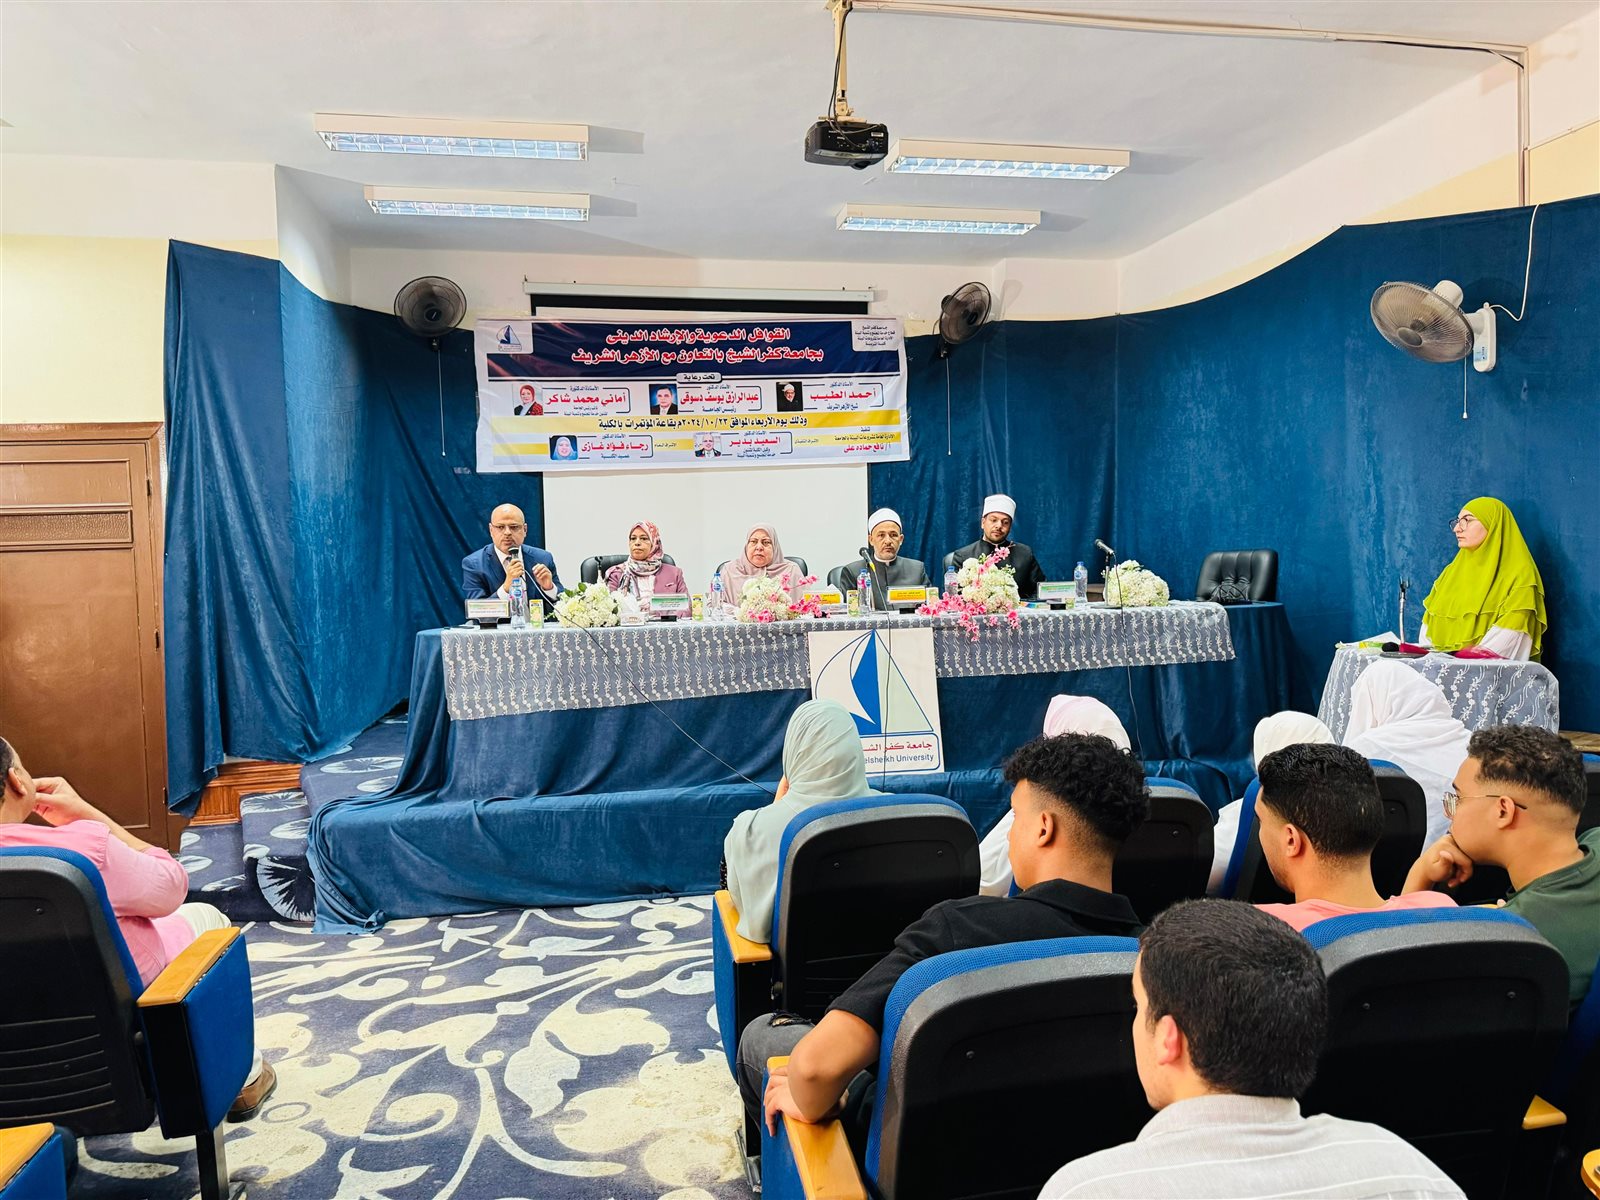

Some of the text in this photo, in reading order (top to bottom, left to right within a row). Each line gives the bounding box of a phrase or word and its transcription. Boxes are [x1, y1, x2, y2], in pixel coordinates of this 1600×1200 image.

[697, 328, 746, 343] الدعوية
[748, 328, 790, 342] القوافل
[571, 347, 824, 366] بجامعة كفر الشيخ بالتعاون مع الأزهر الشريف
[683, 374, 702, 382] رعاية
[546, 393, 571, 404] شاكر
[573, 395, 600, 403] محمد
[705, 391, 725, 405] يوسف
[725, 391, 746, 404] الرازق
[746, 393, 759, 404] عبد
[809, 387, 877, 402] أحمد الطيب
[599, 419, 623, 431] بالكلية
[625, 418, 656, 430] المؤتمرات
[656, 418, 677, 430] بقاعة
[730, 416, 751, 428] الموافق
[776, 417, 788, 427] يوم
[789, 415, 807, 427] وذلك
[606, 440, 625, 452] فؤاد
[625, 441, 648, 451] رجاء
[729, 436, 781, 448] السعيد بدير
[873, 443, 884, 453] نافع
[863, 741, 933, 753] جامعة كفر الش
[865, 753, 934, 765] elshekh University
